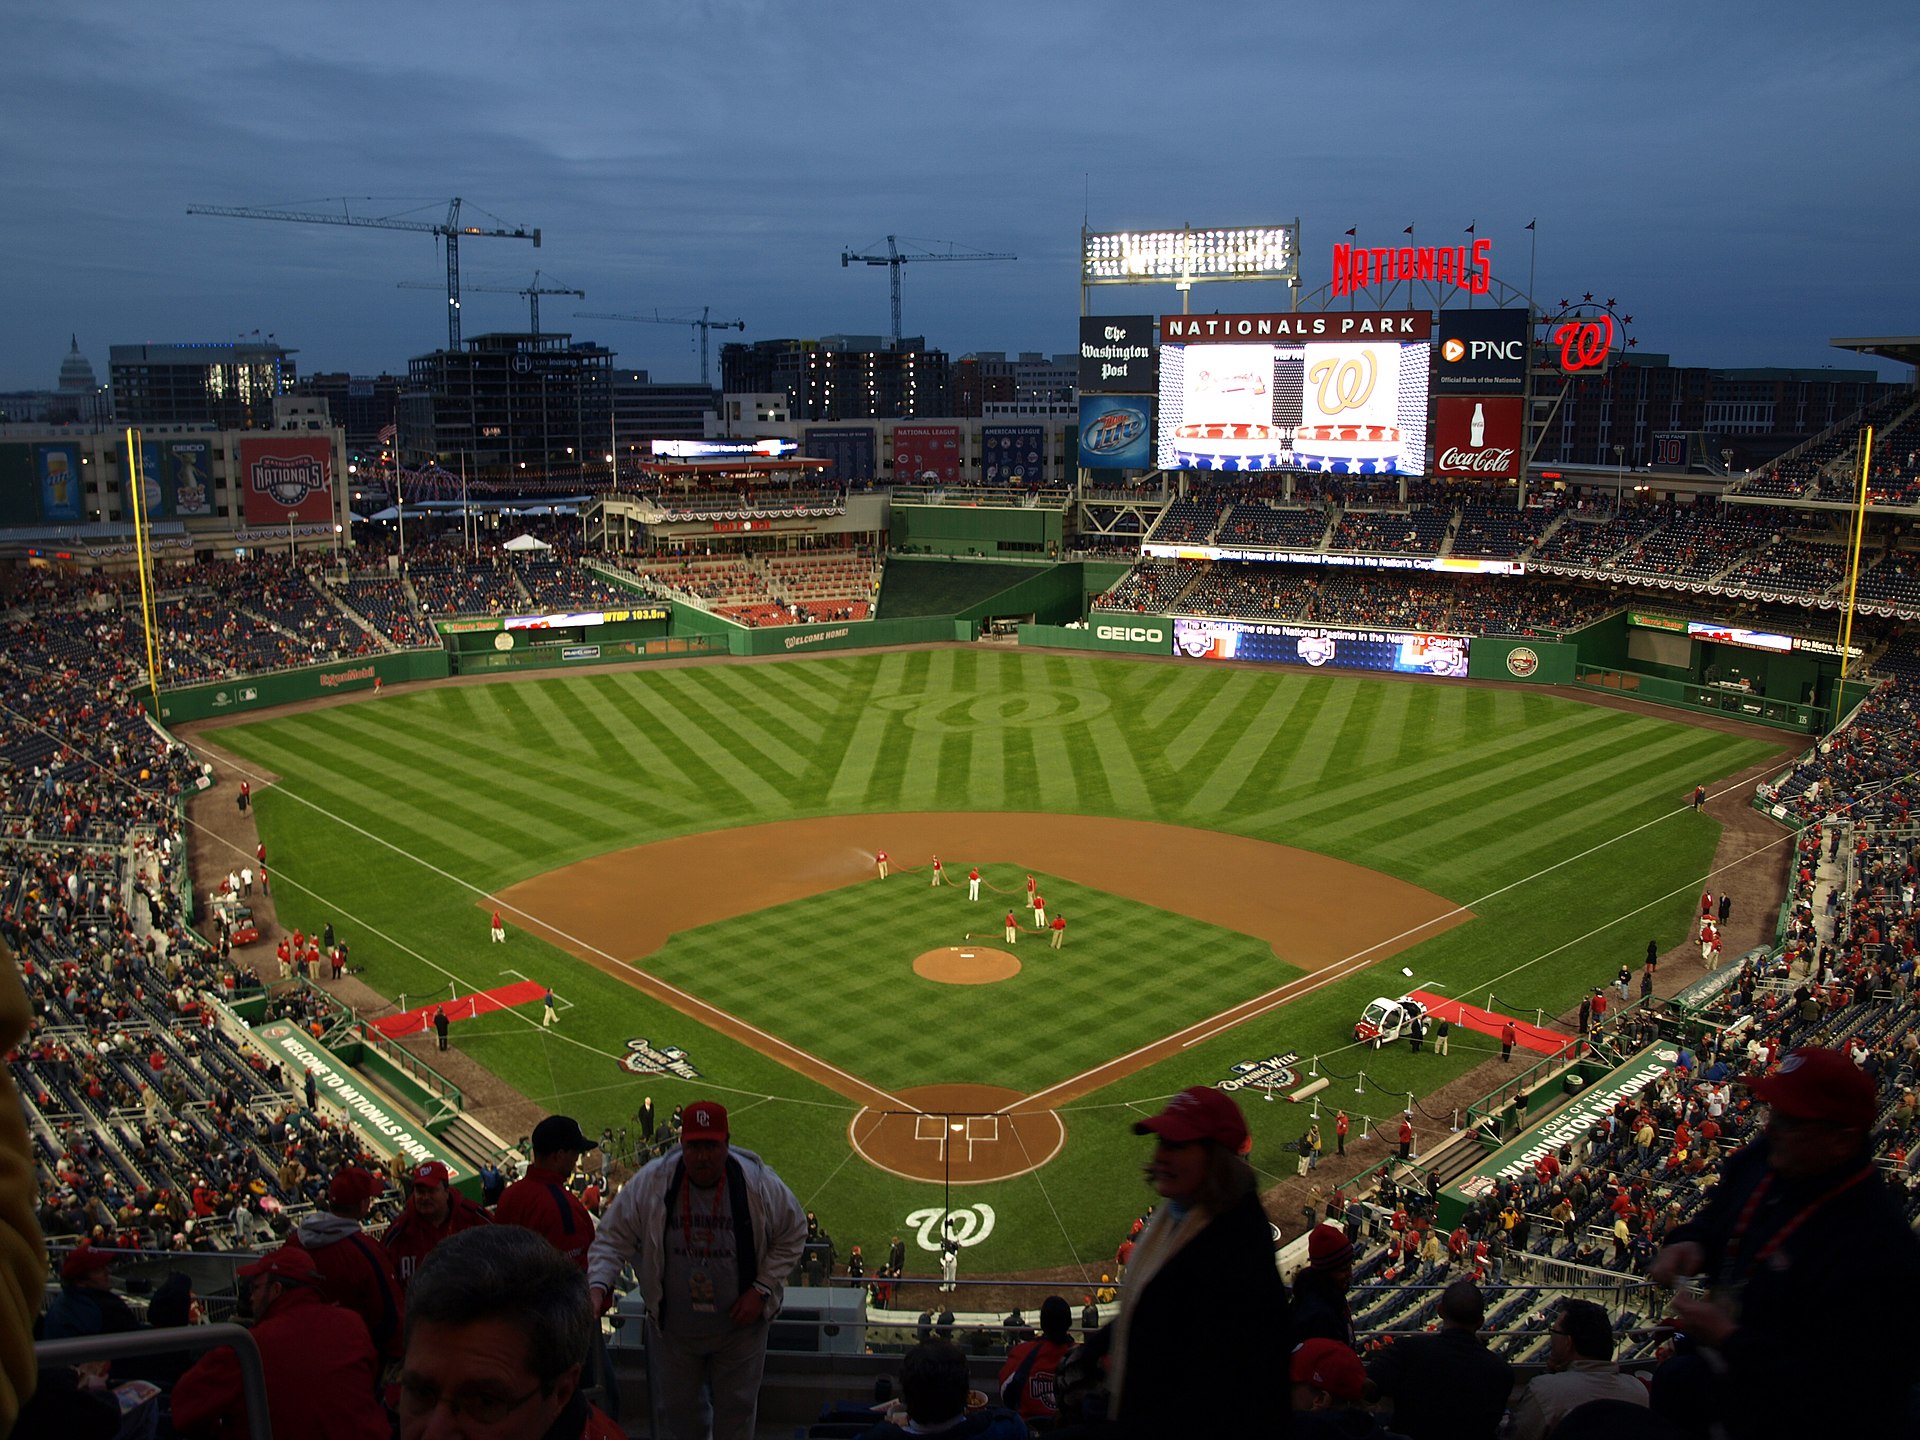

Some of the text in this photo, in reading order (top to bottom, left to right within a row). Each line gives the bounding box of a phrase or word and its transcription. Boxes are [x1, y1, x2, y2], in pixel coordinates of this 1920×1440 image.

[1332, 239, 1491, 297] NATIONALS
[1104, 325, 1126, 342] The
[1169, 317, 1415, 336] NATIONALS PARK
[1081, 342, 1149, 361] Washington
[1469, 341, 1523, 360] PNC
[1554, 314, 1613, 372] W
[1101, 363, 1128, 380] Post
[172, 444, 205, 452] GEICO
[1658, 440, 1681, 464] 10
[1438, 447, 1515, 472] Coca-Cola
[256, 465, 320, 489] NATIONALS
[714, 521, 734, 531] RED
[1243, 551, 1265, 560] Home
[1266, 552, 1275, 561] of
[1276, 553, 1288, 562] the
[1289, 553, 1320, 564] National
[1322, 555, 1354, 565] Pastime
[1355, 556, 1363, 565] in
[1364, 557, 1378, 566] the
[784, 628, 849, 649] WELCOME HOME!
[1097, 625, 1163, 643] GEICO
[1186, 621, 1465, 649] The Official Home of the National Pastime in the Nation's Capital.
[1801, 639, 1811, 647] Go
[280, 1037, 435, 1162] WELCOME TO NATIONALS PARK
[1497, 1063, 1667, 1180] WASHINGTON NATIONALS
[1538, 1088, 1607, 1136] HOME OF THE
[905, 1203, 996, 1251] W
